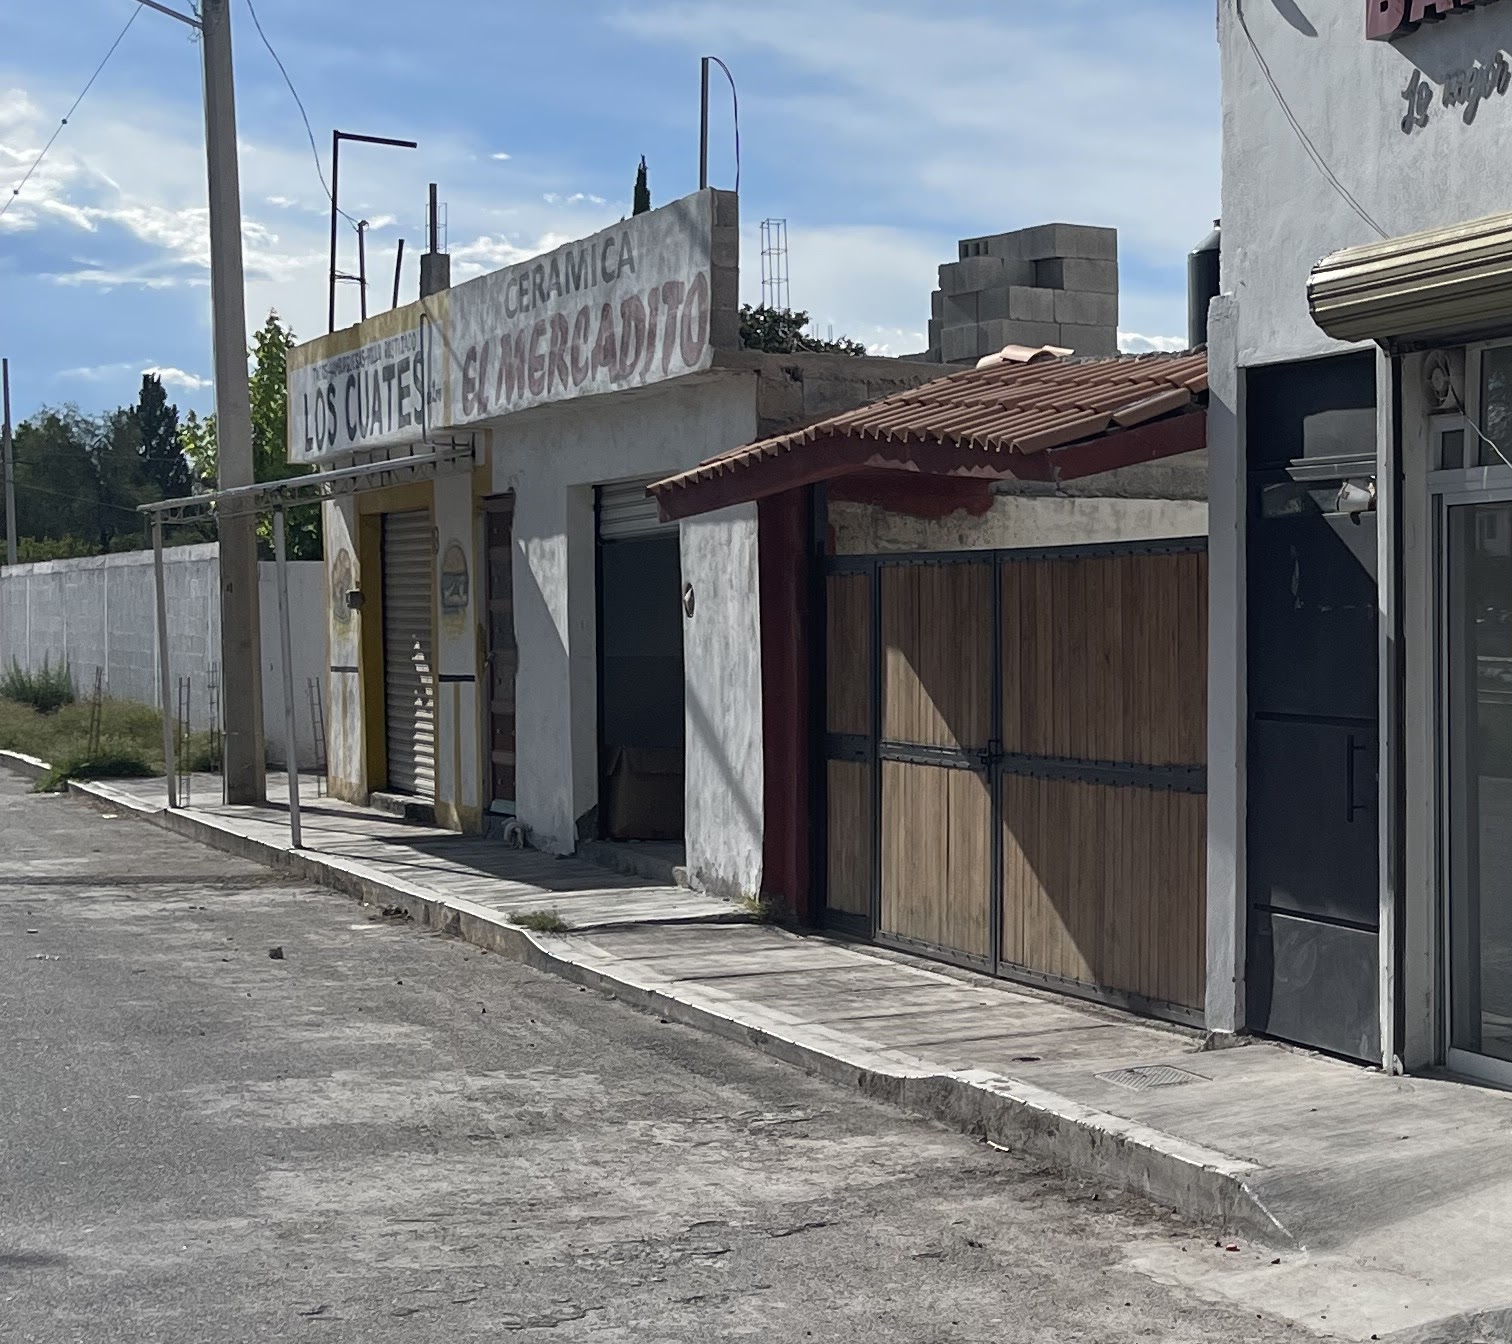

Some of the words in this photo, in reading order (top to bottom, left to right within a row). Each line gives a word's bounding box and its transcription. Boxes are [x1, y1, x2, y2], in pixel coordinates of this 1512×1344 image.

[1443, 52, 1512, 125] mejor
[505, 230, 636, 320] CERAMICA
[495, 271, 709, 406] MERCADITO
[304, 382, 338, 453] LOS
[346, 350, 423, 442] CUATES
